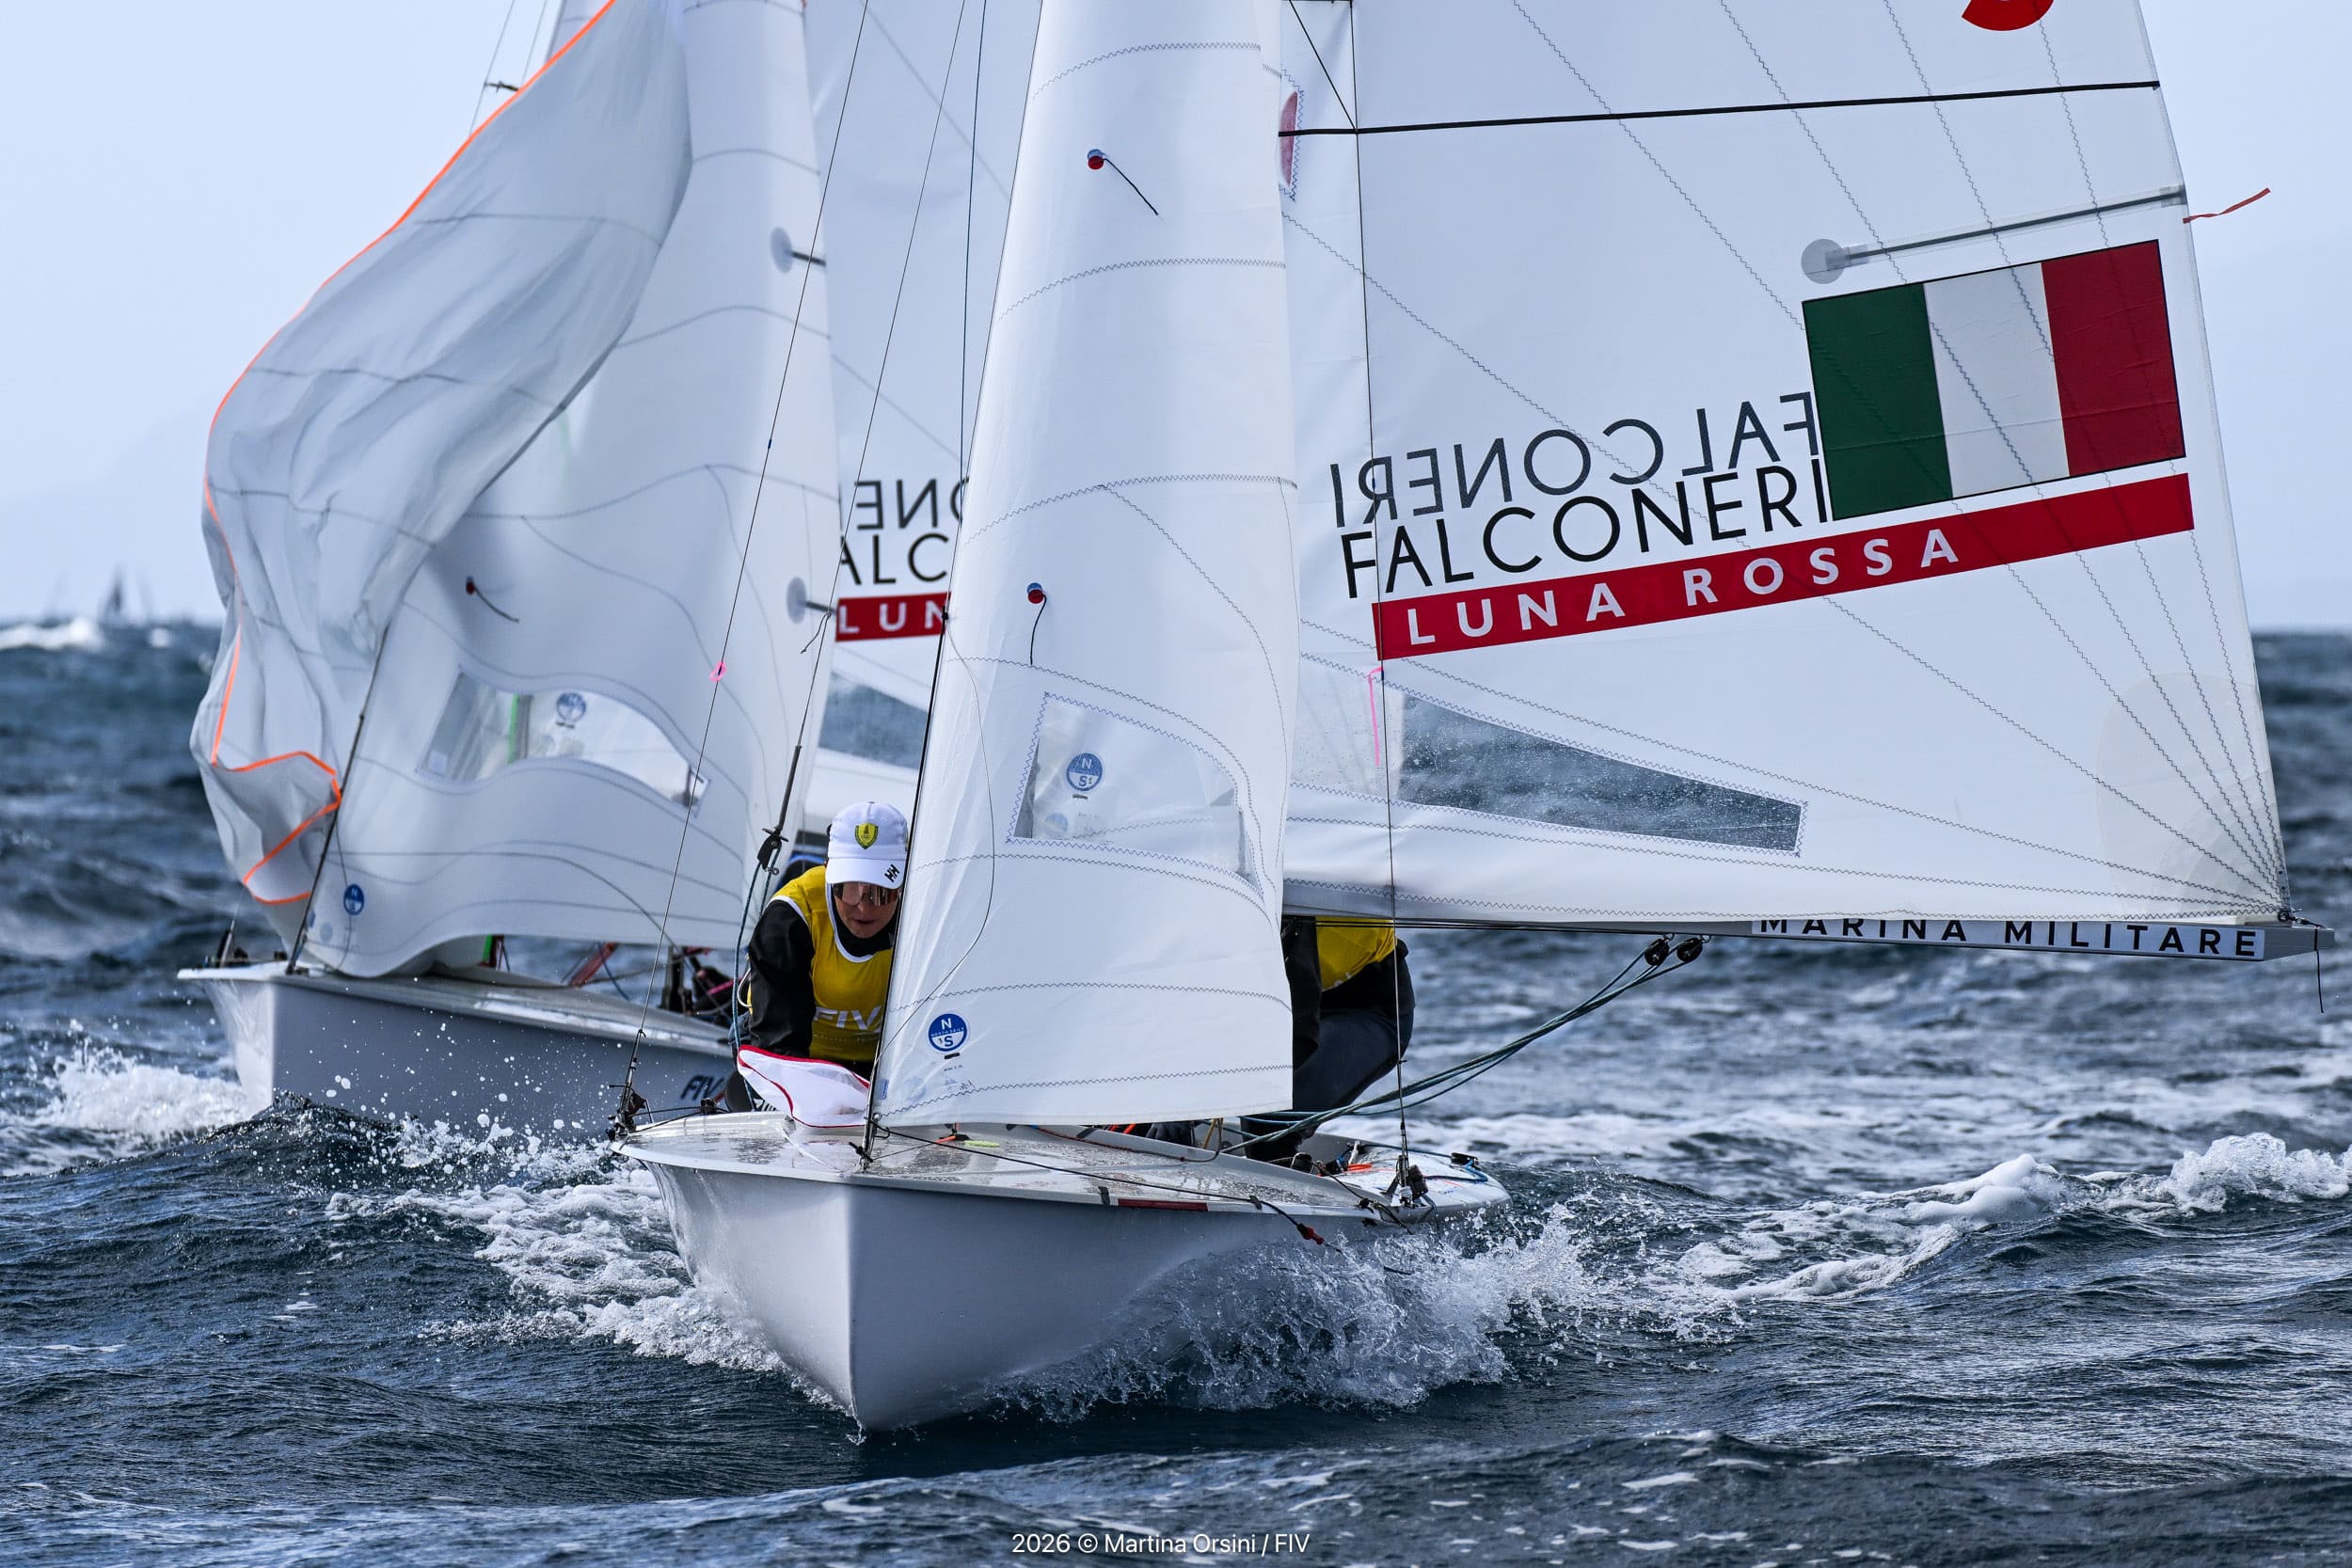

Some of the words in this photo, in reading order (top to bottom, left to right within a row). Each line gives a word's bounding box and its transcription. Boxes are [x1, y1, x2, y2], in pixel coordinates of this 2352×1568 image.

[1341, 458, 1828, 599] FALCONERI
[1407, 582, 1627, 645] LUNA
[1682, 528, 1959, 607] ROSSA
[1760, 918, 1967, 942] MARINA
[2004, 920, 2257, 957] MILITARE
[814, 1006, 882, 1030] FIV
